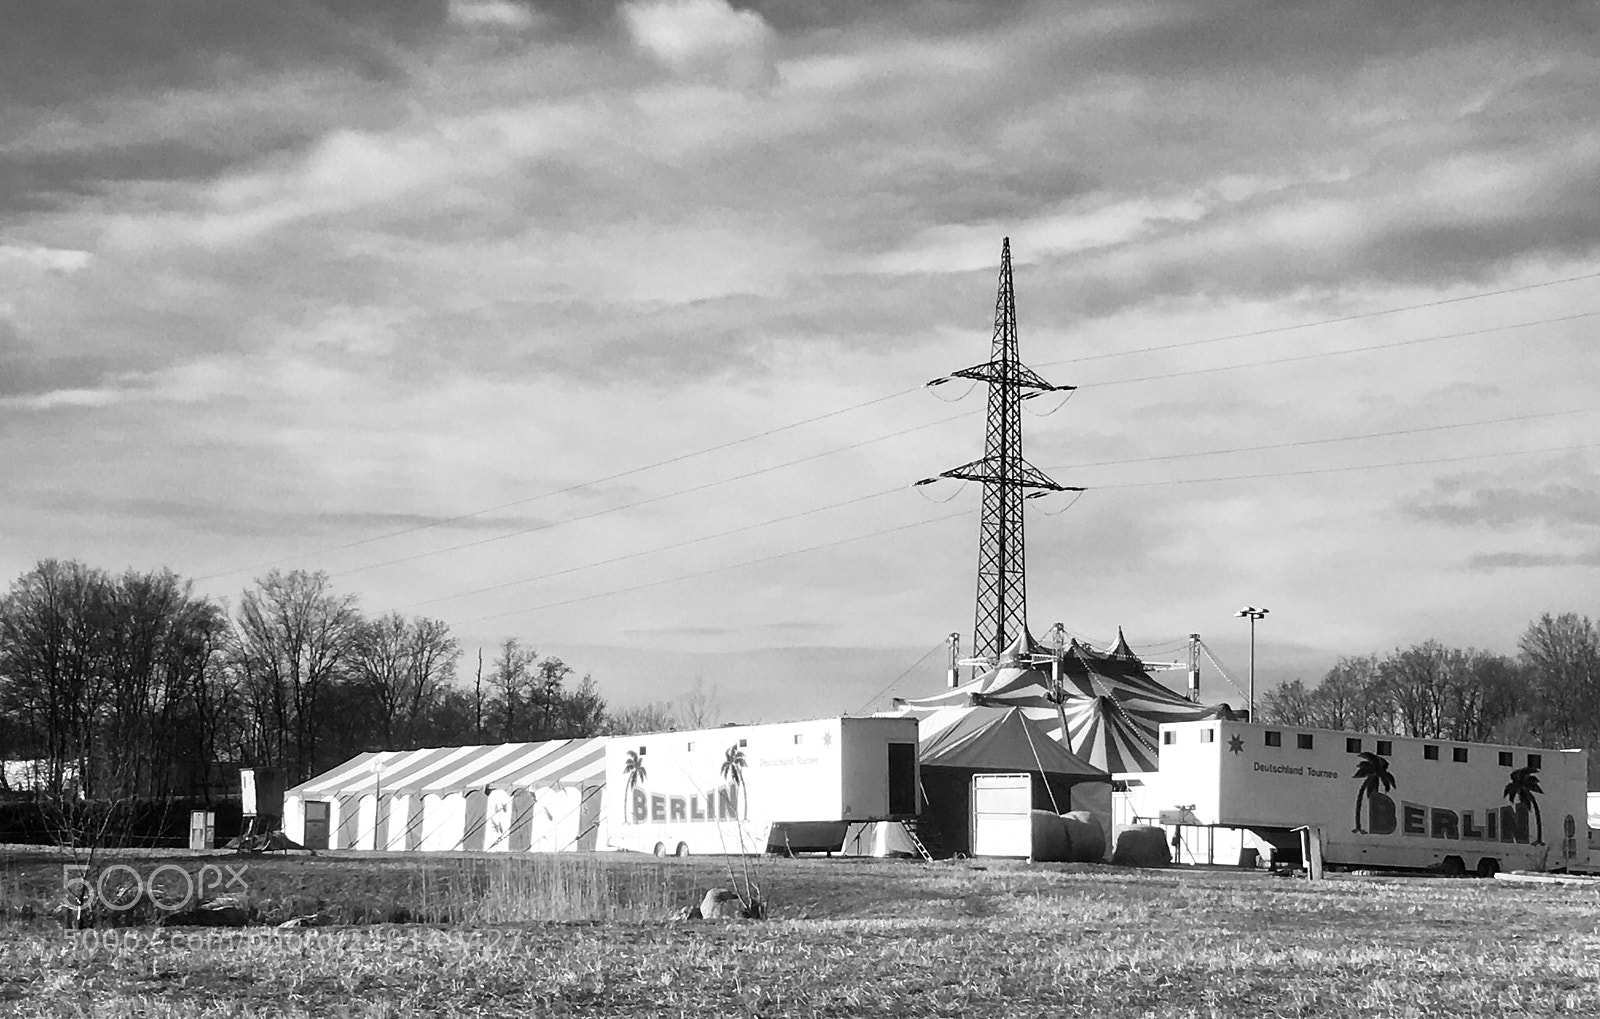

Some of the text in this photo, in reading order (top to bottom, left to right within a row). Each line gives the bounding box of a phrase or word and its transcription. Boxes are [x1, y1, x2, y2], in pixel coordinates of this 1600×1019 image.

[1253, 761, 1338, 779] Deutschland Tournee
[633, 780, 740, 824] BERLIN
[1368, 792, 1530, 844] BERLIN
